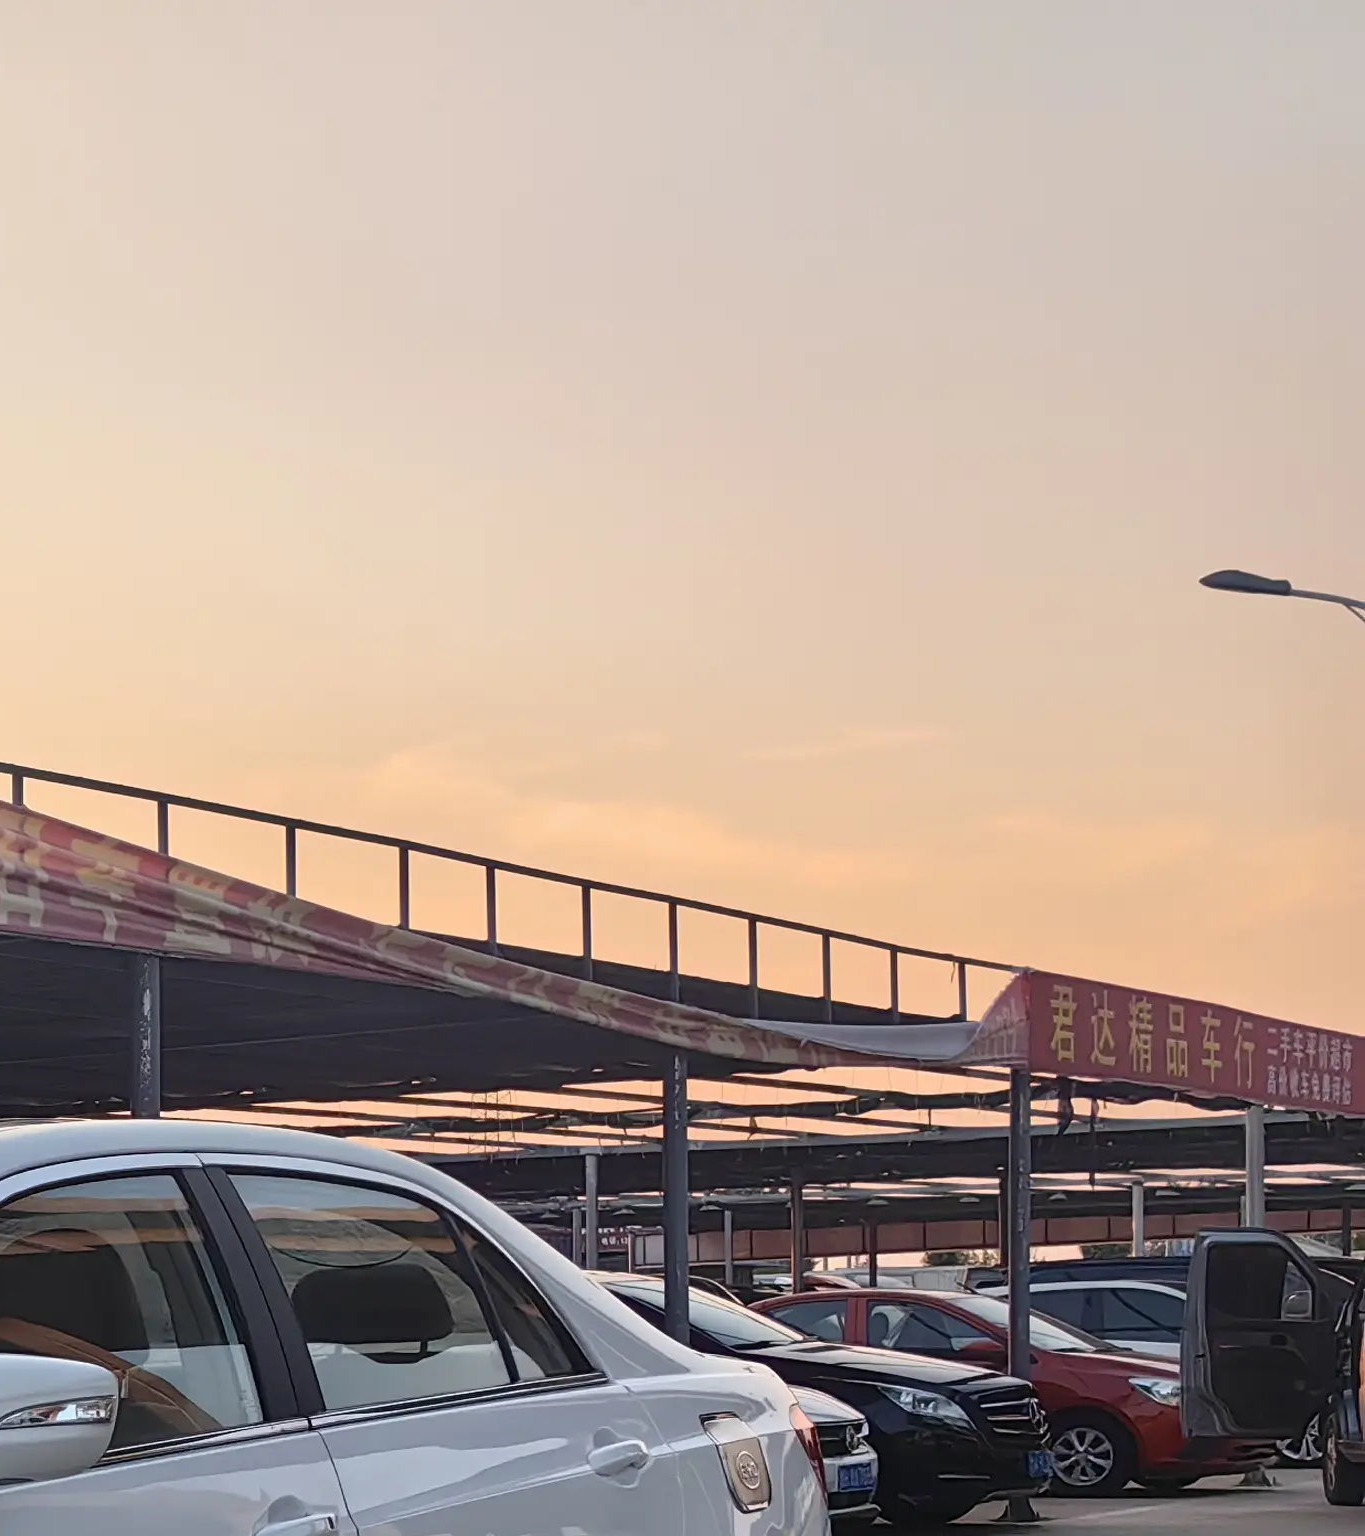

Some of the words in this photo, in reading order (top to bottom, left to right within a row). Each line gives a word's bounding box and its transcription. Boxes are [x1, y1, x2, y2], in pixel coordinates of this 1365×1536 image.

[1050, 984, 1256, 1090] 君达精品车行
